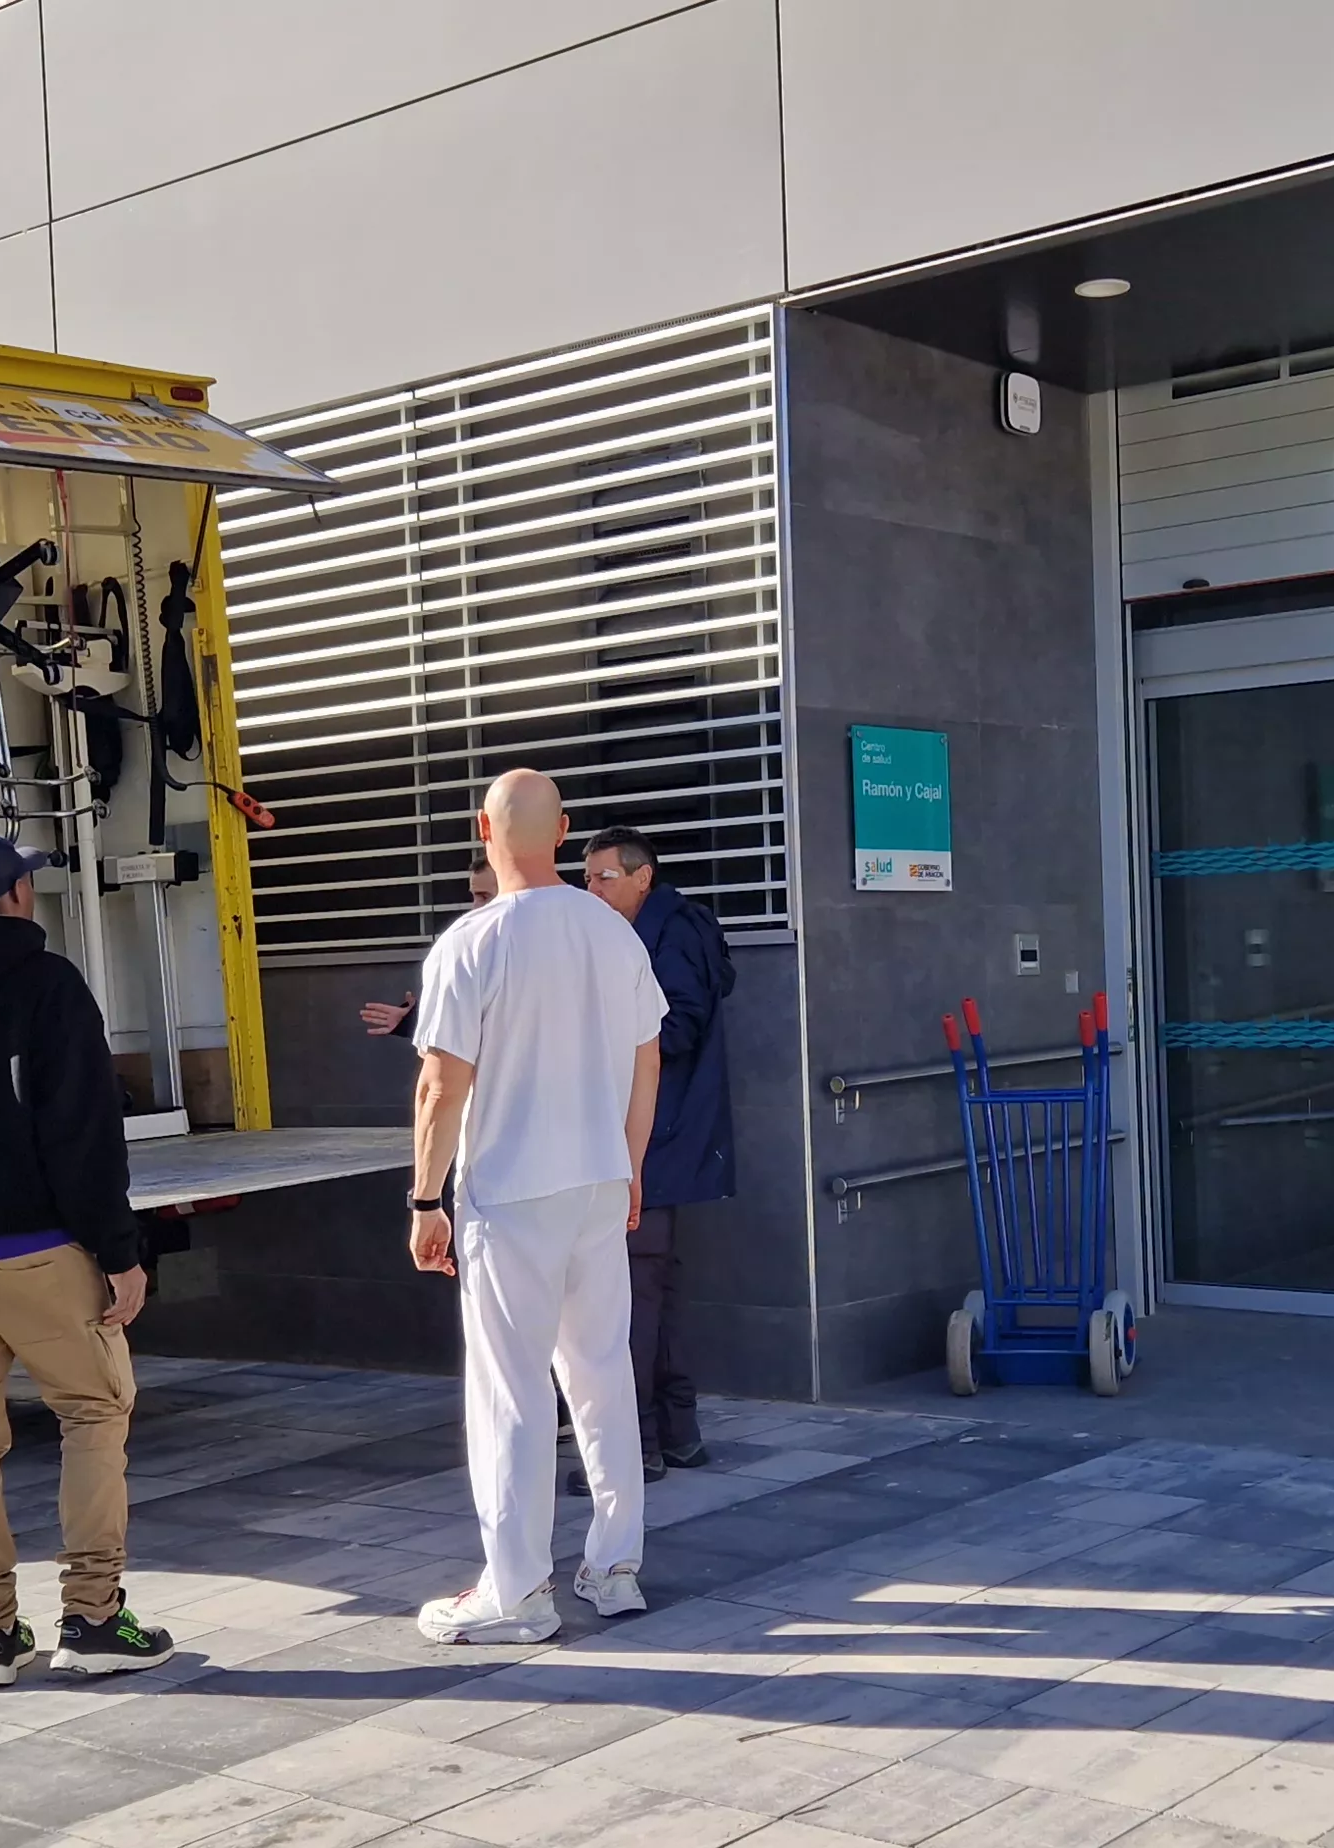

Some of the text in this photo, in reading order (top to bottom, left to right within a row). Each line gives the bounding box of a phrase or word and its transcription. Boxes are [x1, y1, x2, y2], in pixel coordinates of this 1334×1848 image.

[11, 398, 60, 416] sin
[64, 406, 208, 434] conductor
[862, 779, 943, 803] Ramón y Cajal
[864, 856, 893, 873] salud
